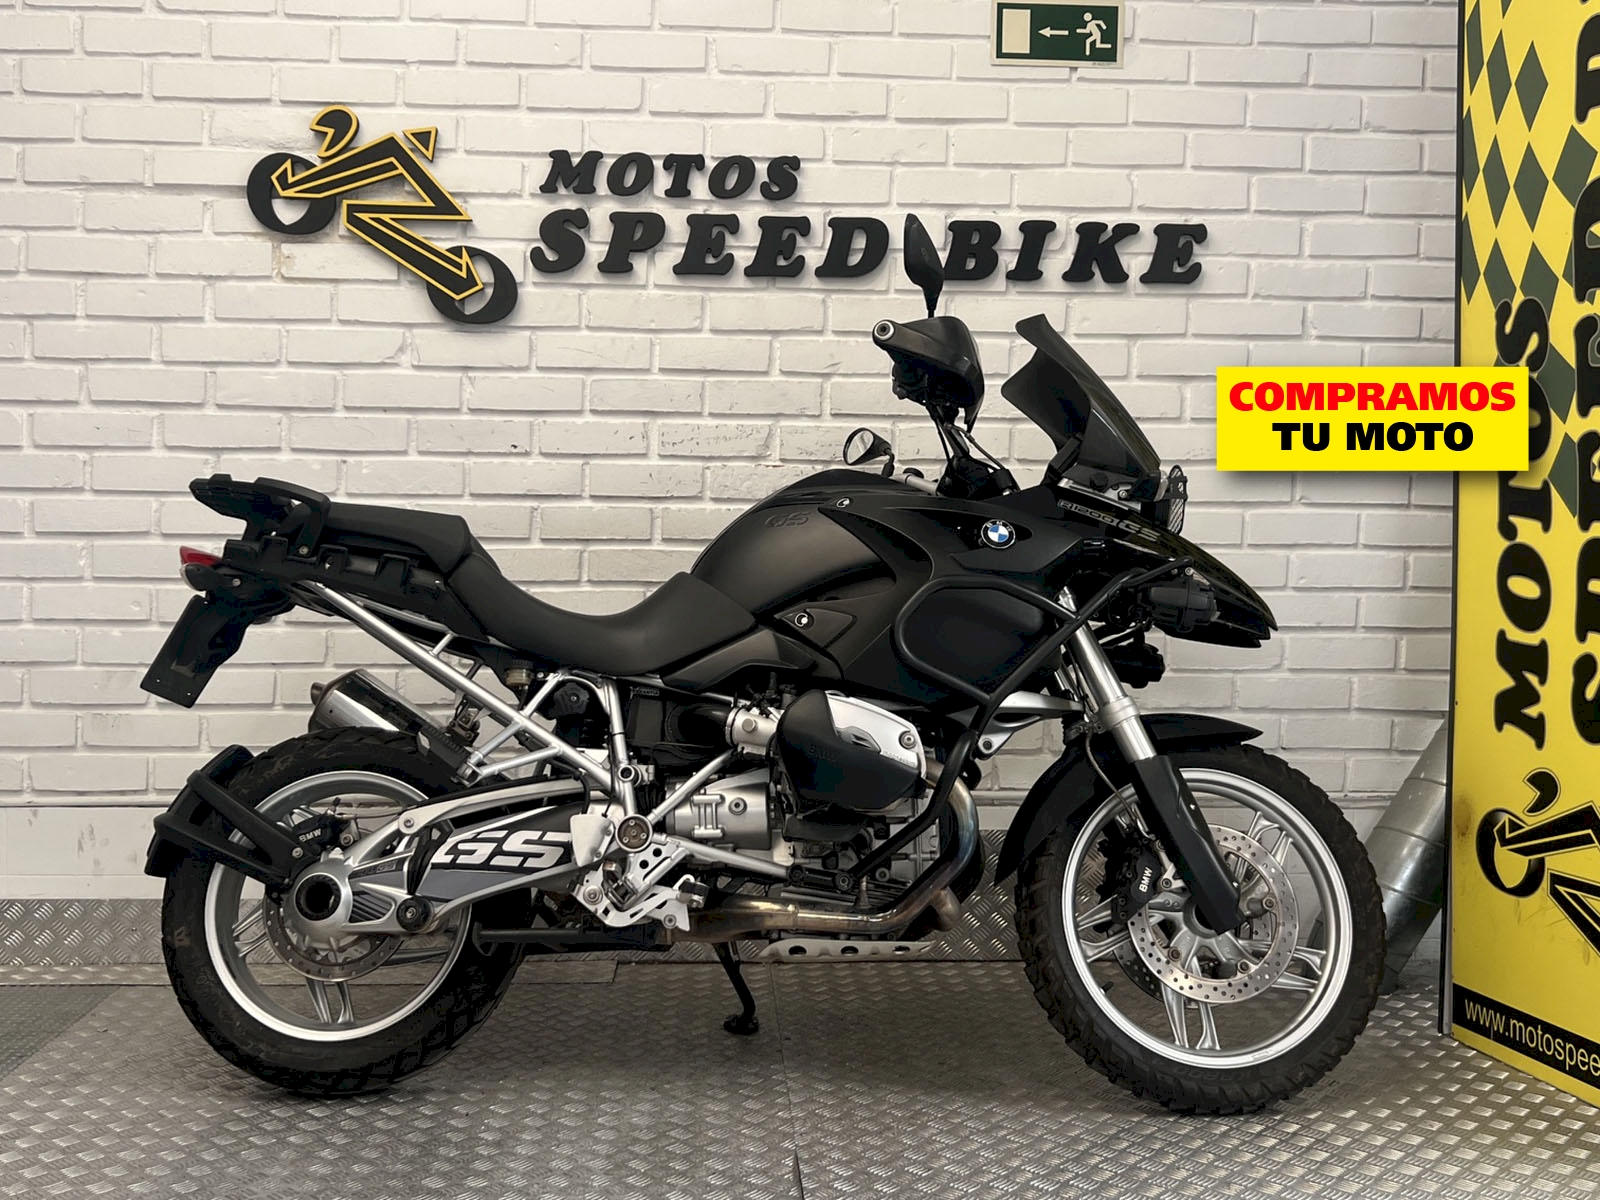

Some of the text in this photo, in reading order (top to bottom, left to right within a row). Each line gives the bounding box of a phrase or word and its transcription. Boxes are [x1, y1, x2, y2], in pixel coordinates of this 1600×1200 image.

[539, 149, 801, 202] MOTOS
[529, 208, 1208, 285] SPEED BIKE
[1117, 519, 1162, 542] GS
[299, 827, 322, 844] BMW
[430, 829, 573, 869] GS
[1138, 866, 1153, 893] BMW
